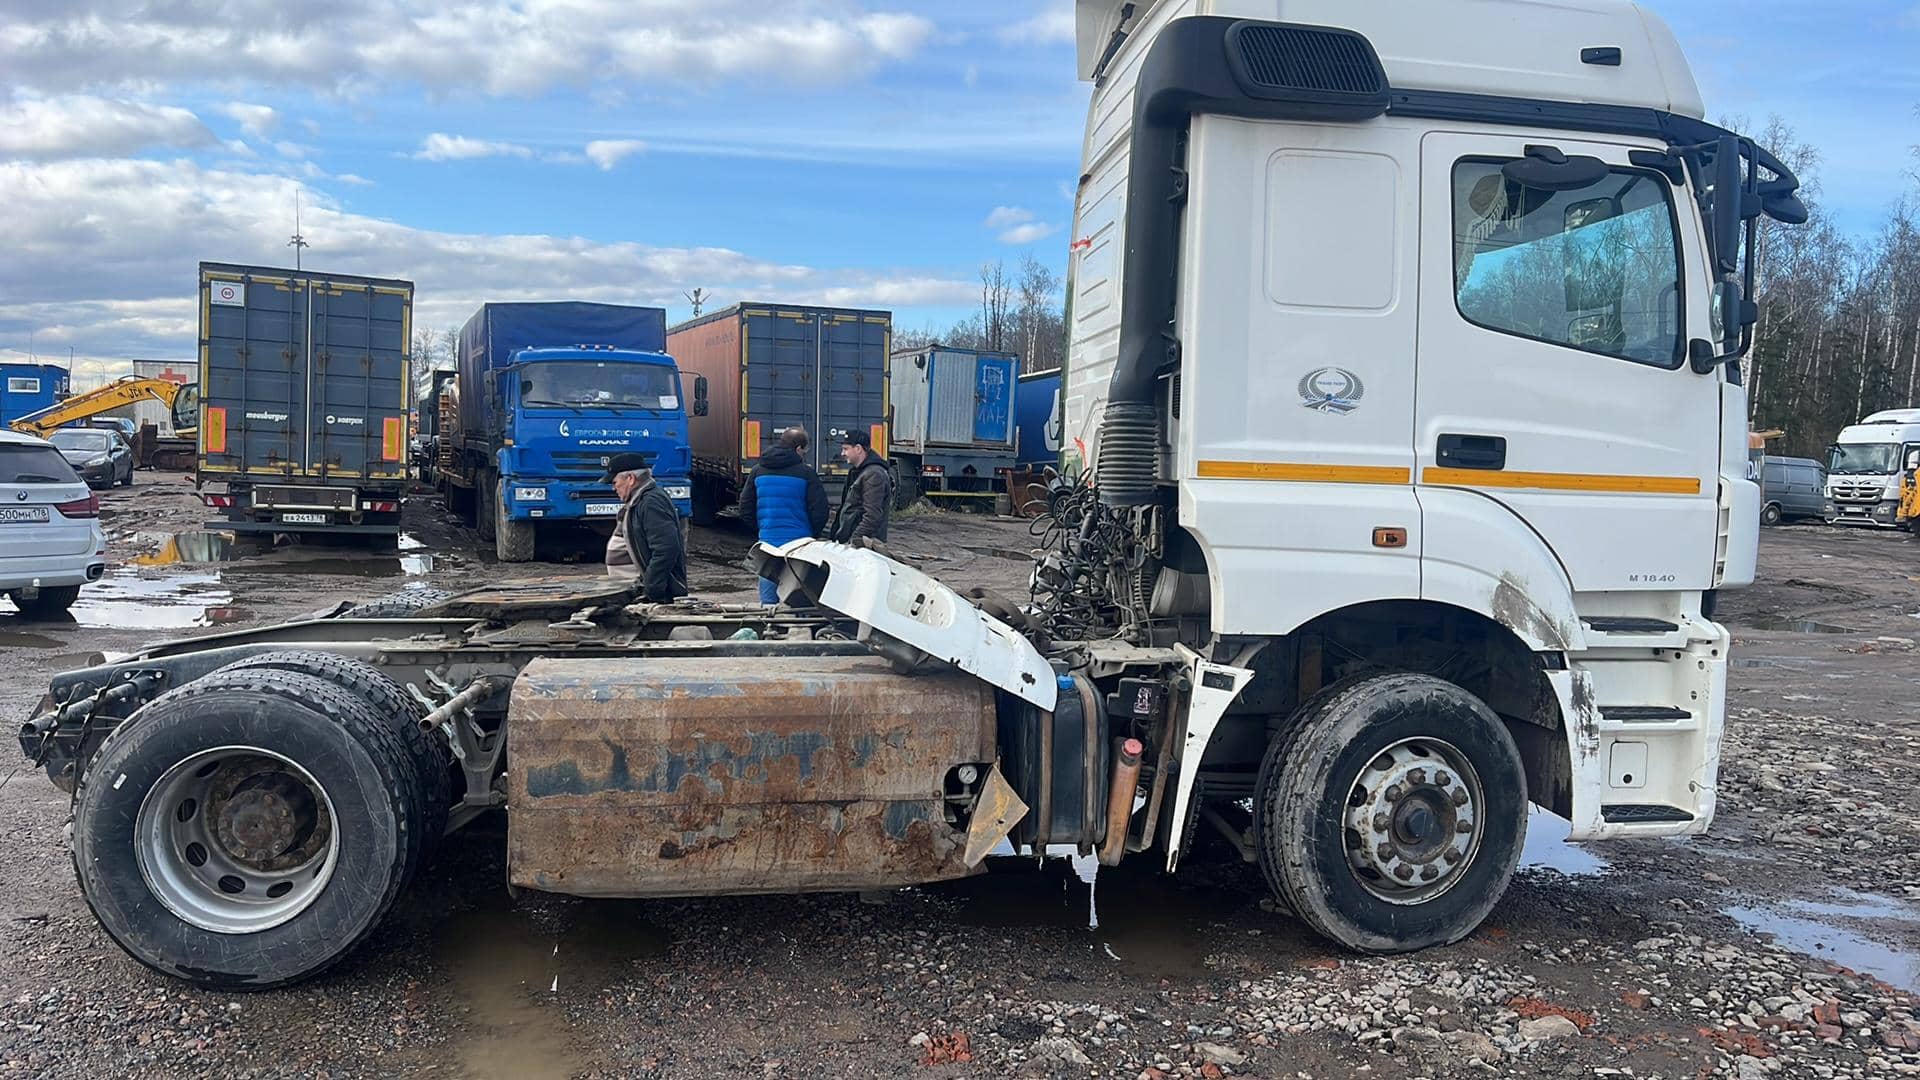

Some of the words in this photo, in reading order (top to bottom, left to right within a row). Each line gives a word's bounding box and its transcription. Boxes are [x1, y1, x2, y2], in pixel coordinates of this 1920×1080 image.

[32, 509, 47, 517] 178
[1629, 574, 1639, 582] M
[1643, 574, 1676, 582] 1840
